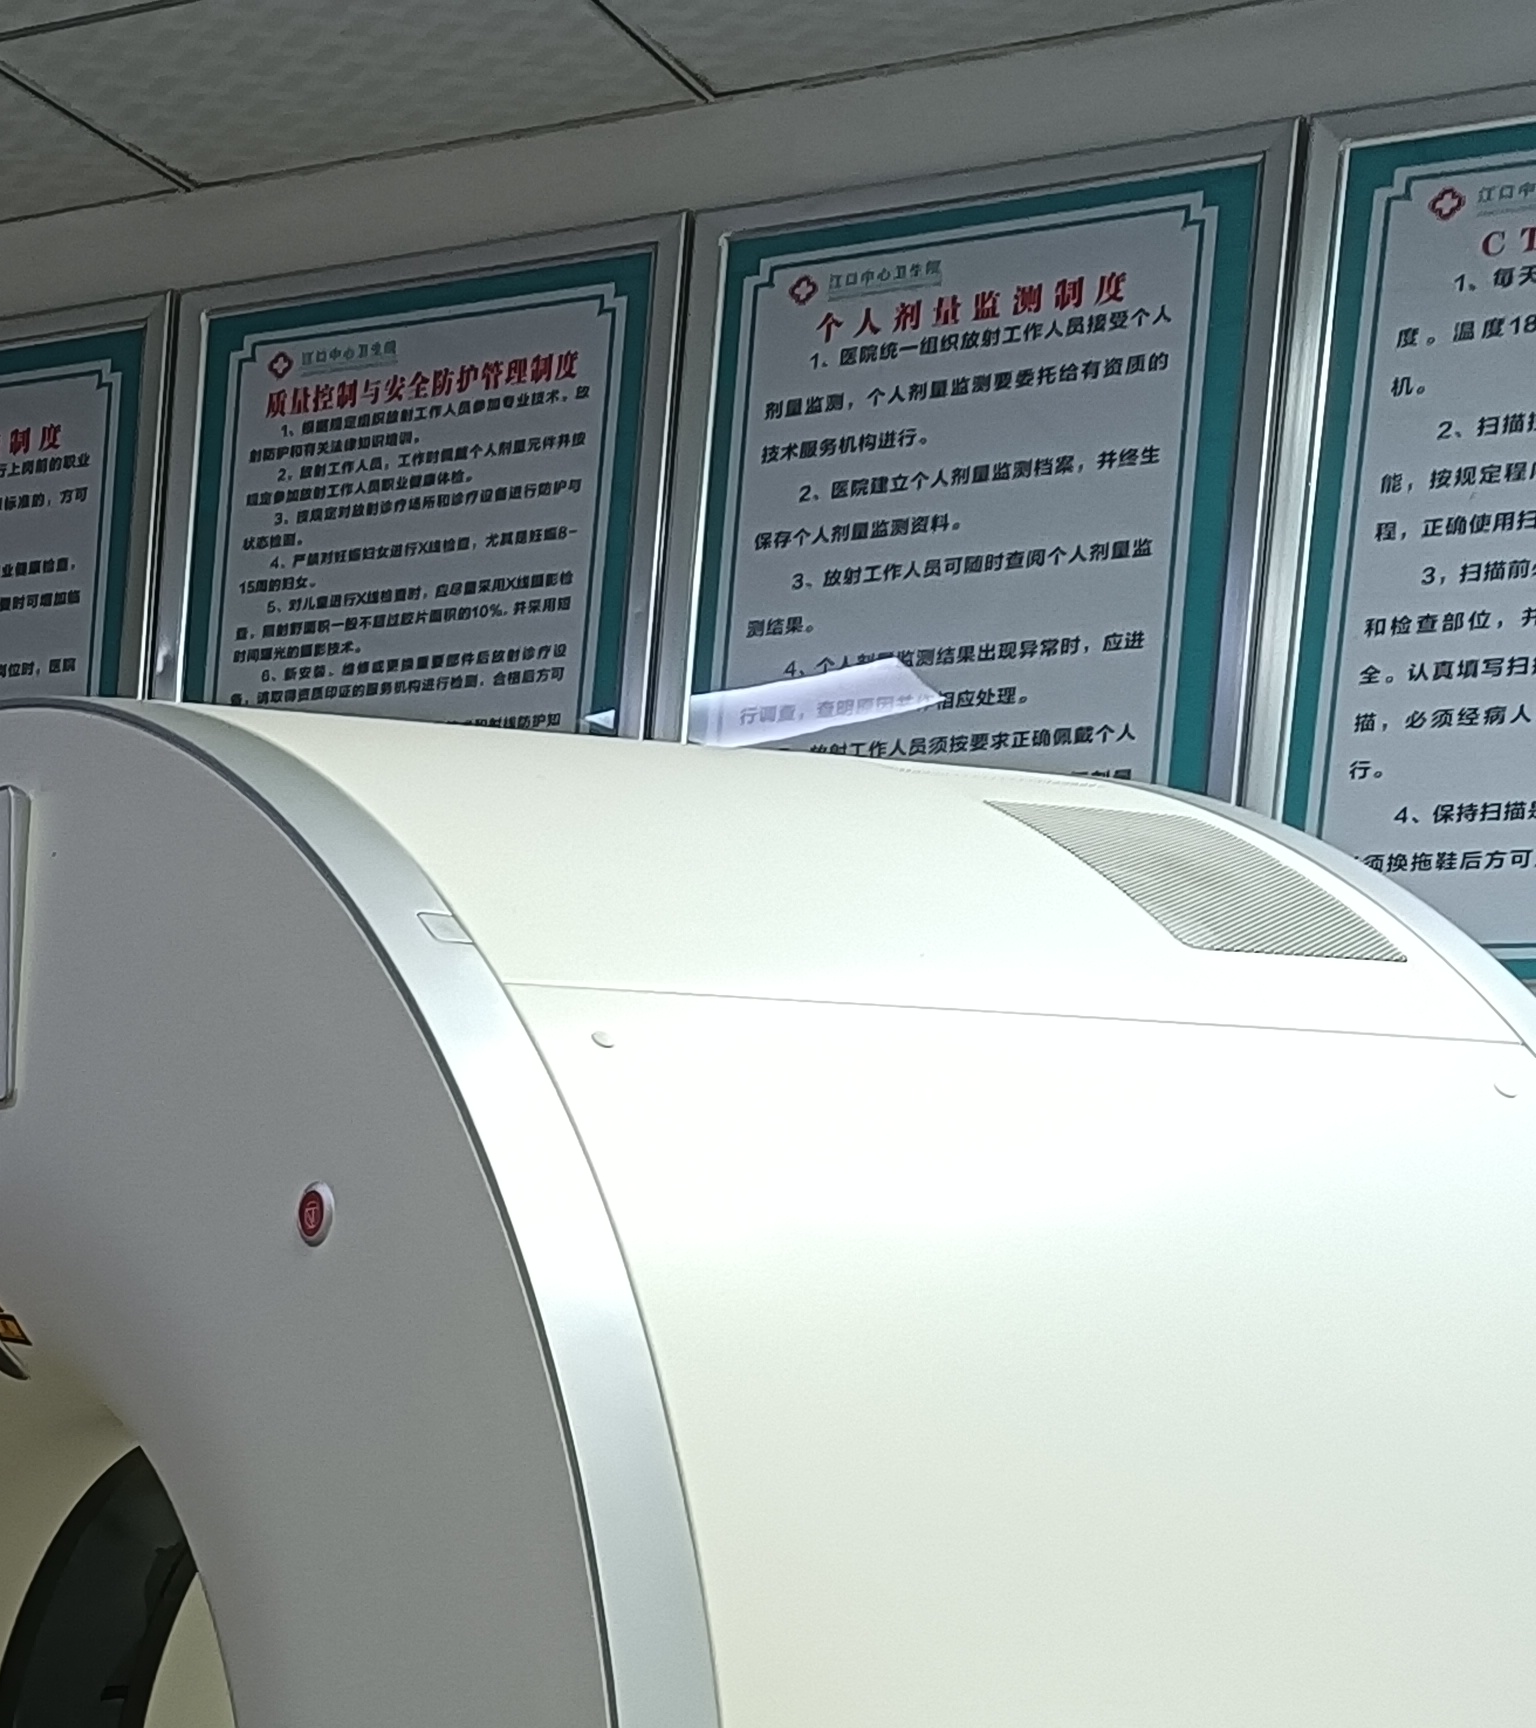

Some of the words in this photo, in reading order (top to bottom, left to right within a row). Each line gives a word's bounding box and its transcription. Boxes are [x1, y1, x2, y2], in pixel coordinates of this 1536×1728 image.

[816, 272, 1126, 343] 个人剂量监测制度
[810, 305, 1171, 370] 1、医院统一组织放射工作人员接受个人
[266, 350, 579, 418] 质量控制与安全防护管理制度
[764, 352, 1169, 420] 剂量监测，个人剂量监测要委托给有资质的
[1391, 377, 1425, 397] 机。
[761, 428, 927, 464] 技术服务机构进行。
[799, 445, 1160, 503] 2、医院建立个人剂量监测档案，并终生
[755, 513, 960, 551] 保存个人剂量监测资料。
[792, 538, 1153, 590] 3、放射工作人员可随时查阅个人剂量监
[746, 616, 814, 638] 测结果。
[1358, 656, 1536, 686] 全。认真填写扫
[1354, 704, 1531, 733] 描，必须经病人
[1349, 761, 1383, 780] 行。
